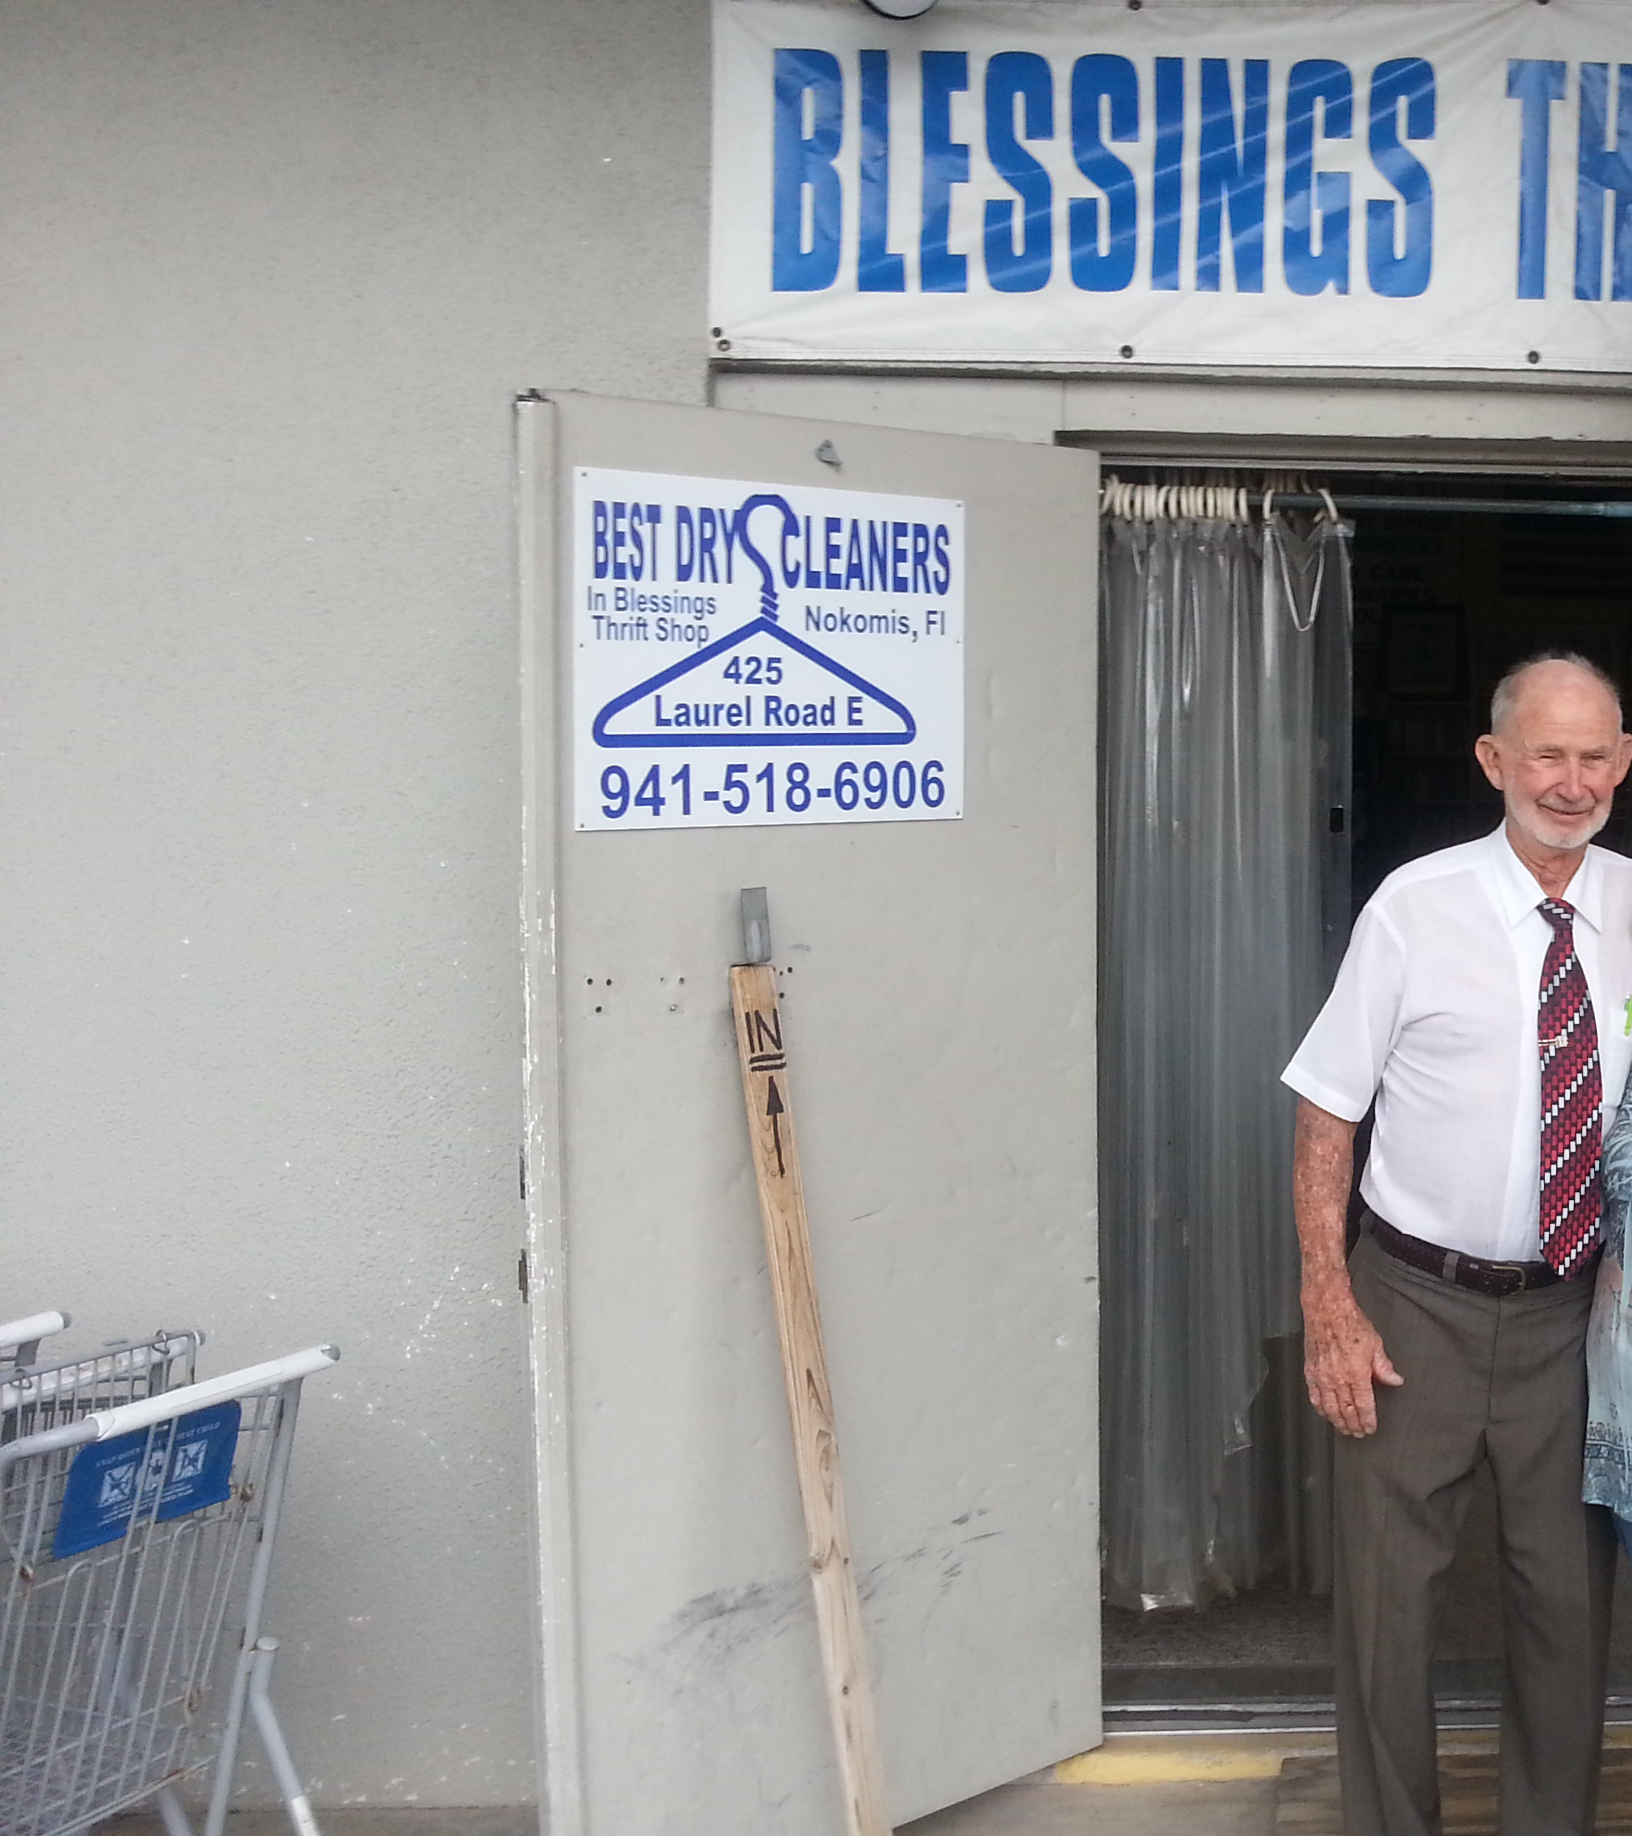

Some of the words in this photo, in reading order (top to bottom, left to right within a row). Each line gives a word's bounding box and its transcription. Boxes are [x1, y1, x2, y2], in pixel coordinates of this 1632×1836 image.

[771, 47, 1437, 298] BLESSINGS
[593, 500, 661, 582] BEST
[676, 505, 741, 584] DRY
[781, 514, 950, 596] CLEANERS
[588, 586, 607, 612] In
[615, 588, 717, 620] Blessings
[592, 615, 648, 642] Thrift
[656, 618, 709, 648] Shop
[805, 605, 918, 643] Nokomis,
[723, 656, 783, 685] 425
[655, 695, 751, 727] Laurel
[764, 696, 836, 727] Road
[848, 696, 864, 726] E
[601, 760, 945, 819] 941-518-6906
[745, 1008, 783, 1053] IN
